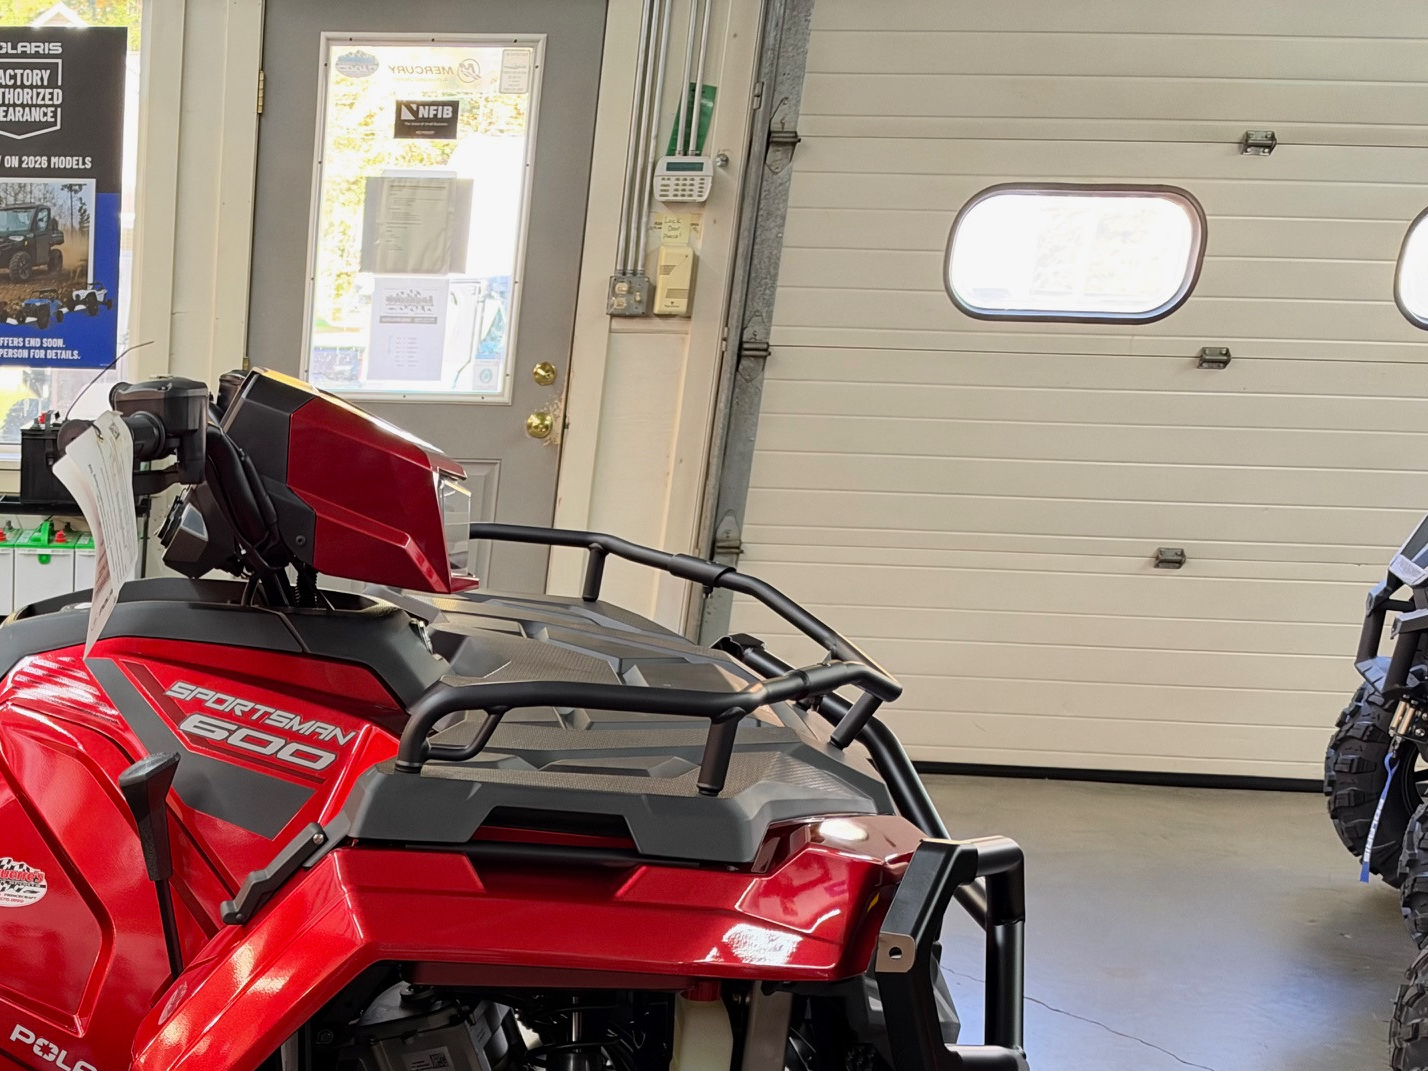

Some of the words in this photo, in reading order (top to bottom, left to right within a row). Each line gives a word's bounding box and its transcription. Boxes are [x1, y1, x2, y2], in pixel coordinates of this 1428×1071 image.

[418, 105, 453, 118] NFIB
[4, 156, 19, 168] ON
[22, 156, 48, 168] 2026
[51, 156, 92, 169] MODELS
[25, 338, 41, 347] END
[42, 338, 65, 348] SOON.
[30, 349, 45, 359] FOR
[47, 350, 81, 360] DETAILS.
[164, 680, 356, 746] SPORTSMAN
[179, 711, 336, 771] 600
